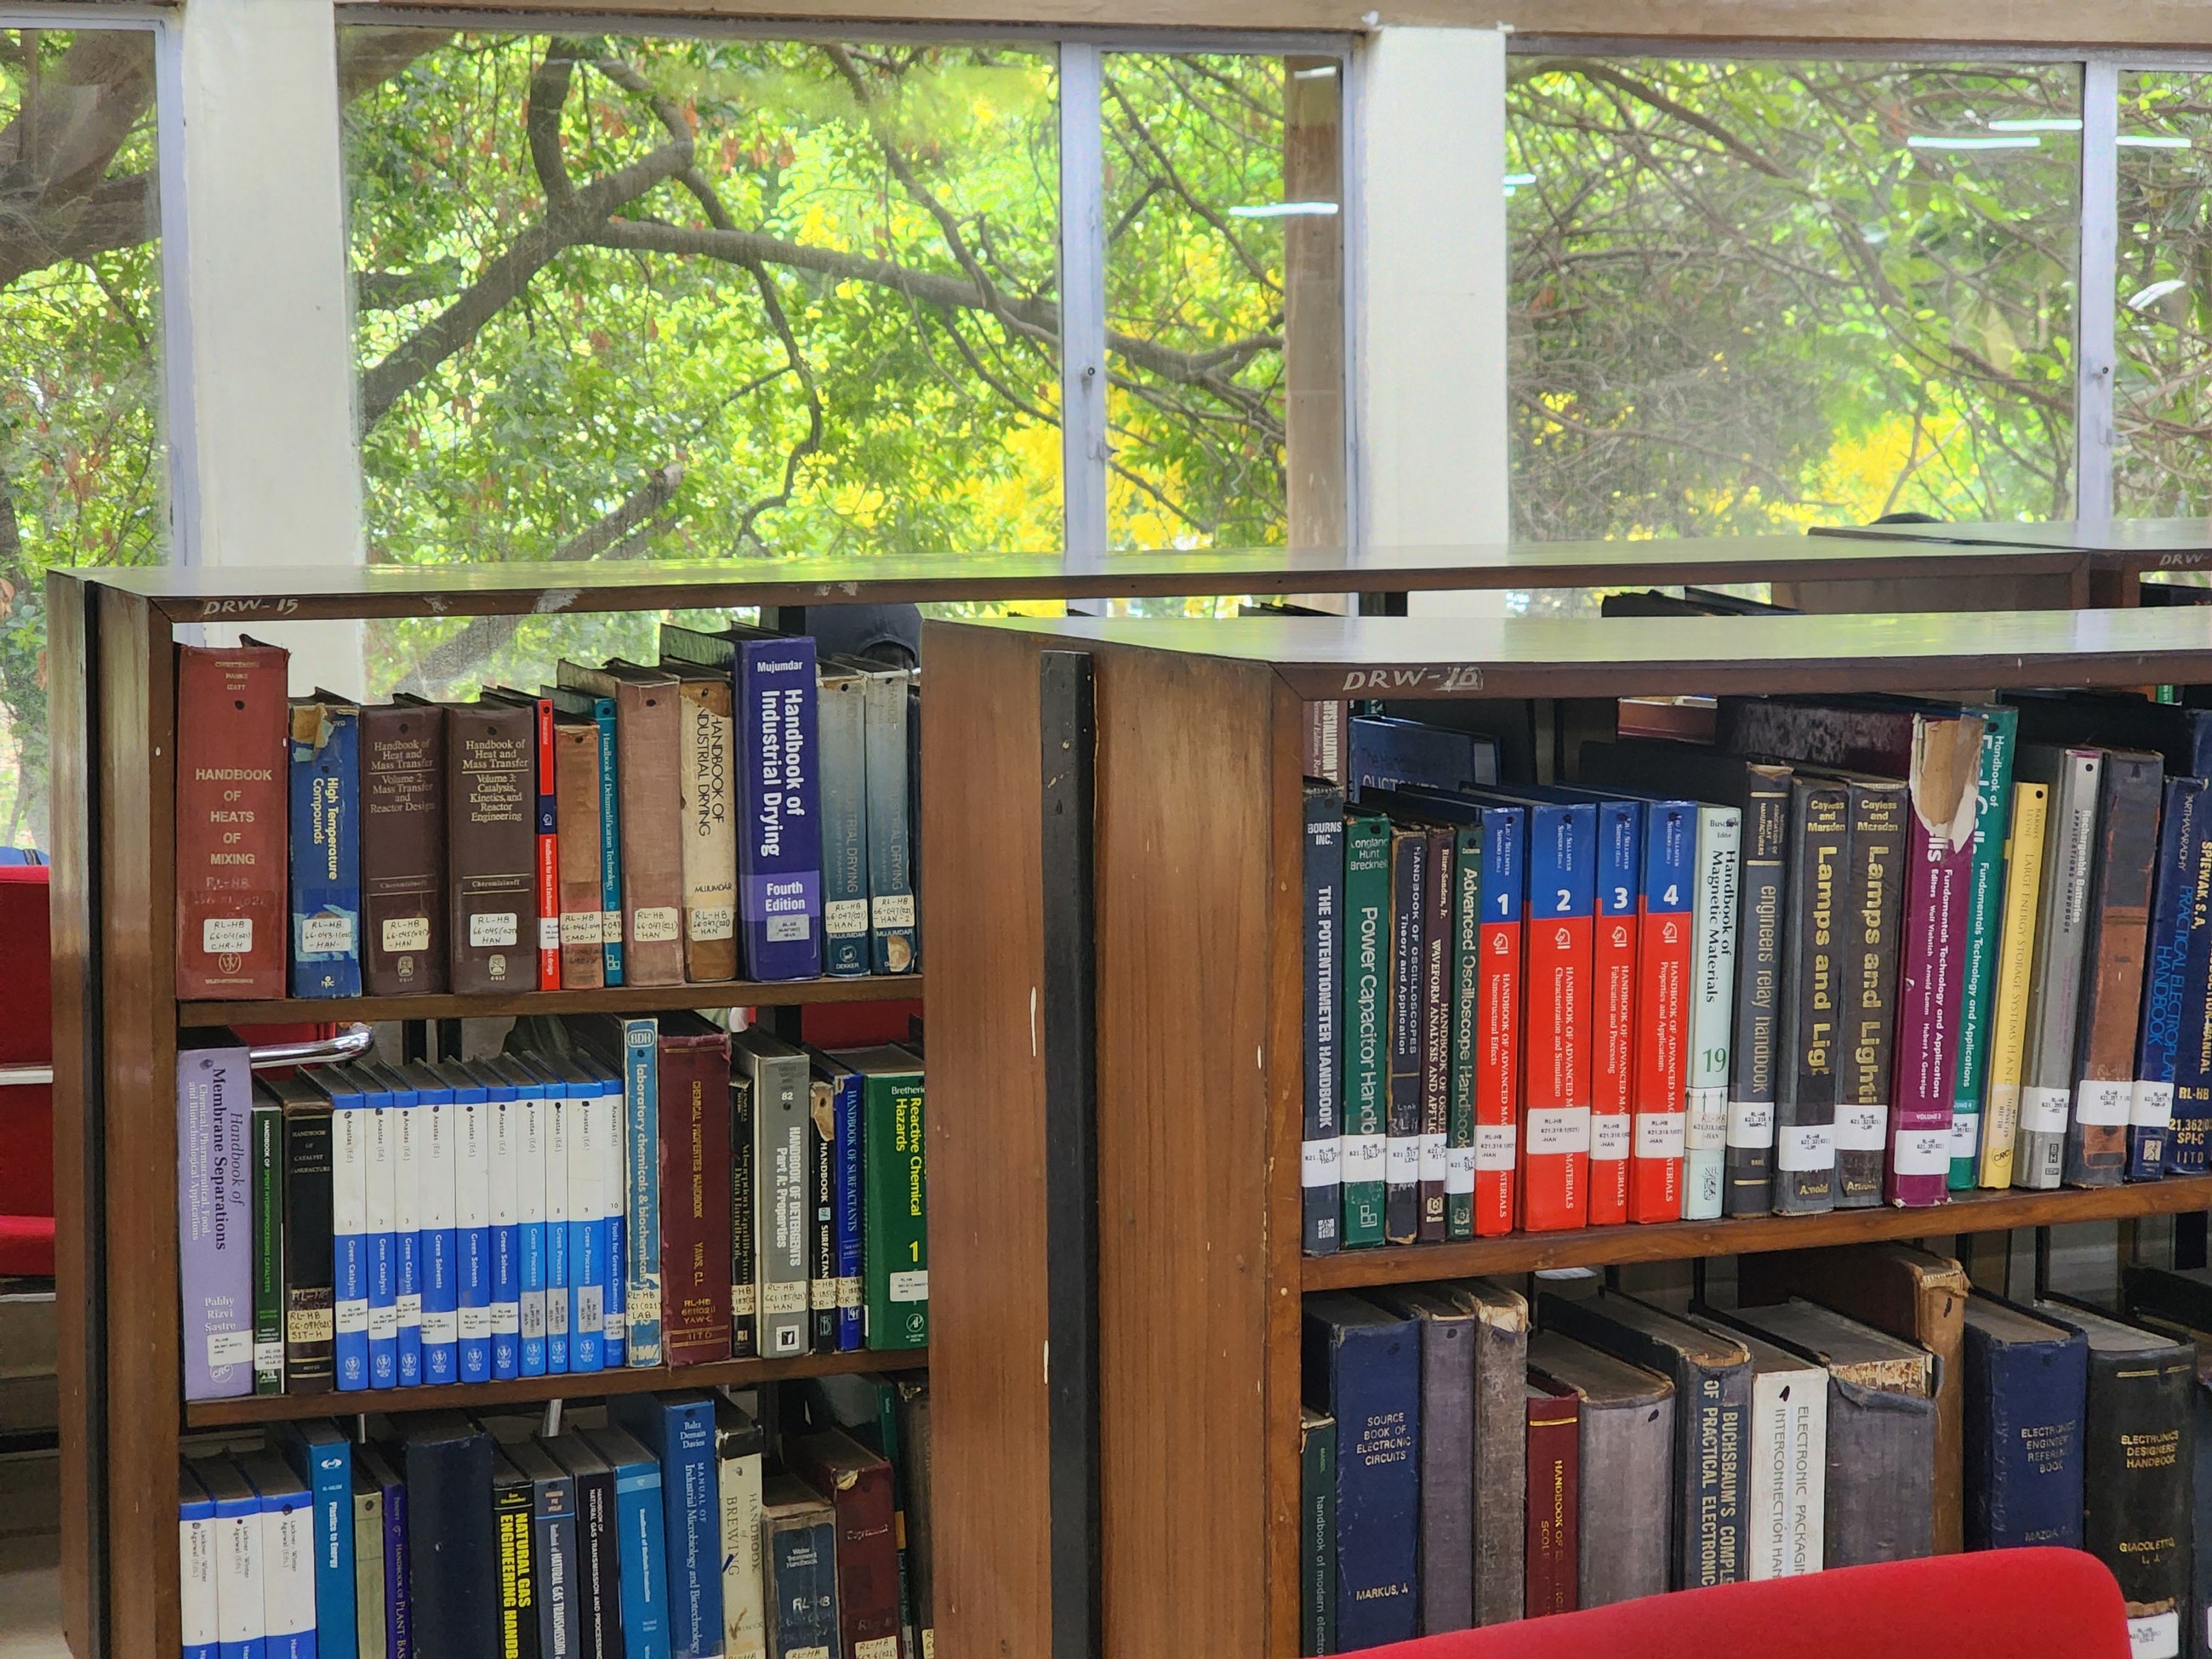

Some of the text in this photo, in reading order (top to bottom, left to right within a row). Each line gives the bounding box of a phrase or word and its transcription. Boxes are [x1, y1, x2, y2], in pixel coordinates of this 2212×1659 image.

[757, 661, 803, 674] Mujumdar
[463, 758, 528, 769] Mass Transfer
[475, 749, 516, 759] Heat and
[784, 689, 805, 816] Handbook of
[196, 769, 271, 781] HANDBOOK
[761, 690, 784, 857] Industrial Drying
[224, 790, 242, 801] OF
[313, 778, 325, 844] Compounds
[481, 801, 513, 812] Reactor
[211, 812, 254, 823] HEATS
[328, 777, 339, 880] High Temperature
[471, 812, 522, 823] Engineering
[1308, 823, 1343, 834] BOURNS
[223, 833, 241, 843] OF
[1316, 834, 1333, 845] INC.
[1359, 849, 1380, 859] Hunt
[211, 854, 254, 865] MIXING
[2073, 809, 2091, 924] Rechargeable Batteries
[767, 882, 803, 896] Fourth
[1614, 887, 1628, 909] 3
[1663, 885, 1679, 906] 4
[1929, 869, 1938, 898] Editors
[766, 898, 806, 911] Edition
[1318, 885, 1332, 916] THE
[1497, 894, 1508, 915] 1
[1556, 889, 1571, 911] 2
[1722, 850, 1736, 956] Handbook of
[1928, 904, 1936, 922] Wolf
[1706, 850, 1723, 1003] Magnetic Materials
[1812, 846, 1838, 1011] Lamps and
[1861, 846, 1890, 1008] Lamps and
[1926, 924, 1936, 957] Vielstich
[2172, 884, 2194, 972] PRACTICAL
[1318, 919, 1333, 1043] POTENTIOMETER
[1359, 906, 1378, 1069] Power Capacitor
[1399, 913, 1409, 1056] Theory and Application
[1756, 966, 1773, 1009] relay
[1924, 963, 1933, 989] Arnold
[1932, 869, 1953, 1099] Fundamentals Technology and Applications
[1429, 938, 1441, 1092] WAVEFORM ANALYSIS AND
[1668, 961, 1679, 1090] HANDBOOK OF ADVANCED
[630, 1031, 651, 1044] BDH
[1702, 1047, 1726, 1073] 19
[1752, 1014, 1771, 1094] handbook
[782, 1092, 794, 1101] 82
[1318, 1045, 1332, 1129] HANDBOOK
[895, 1097, 907, 1152] Hazards
[212, 1069, 227, 1251] Membrane Separations
[636, 1063, 649, 1282] laboratory chemicals & biochemicals
[847, 1090, 857, 1232] HANDBOOK OF SURFACTANTS
[909, 1097, 921, 1216] Reactive Chemical
[790, 1126, 801, 1267] HANDBOOK OF DETERGENTS
[818, 1142, 830, 1221] HANDBOOK of
[775, 1148, 788, 1248] Part A: Properties
[909, 1241, 918, 1262] 1
[347, 1263, 356, 1297] Catalysis
[204, 1320, 237, 1332] Sastre
[207, 1309, 234, 1320] Rizvi
[681, 1429, 706, 1440] Demain
[1364, 1425, 1406, 1440] BOOK OF
[1367, 1412, 1404, 1425] SOURCE
[682, 1439, 705, 1448] Davies
[1356, 1436, 1411, 1454] ELECTRONIC
[1365, 1451, 1406, 1466] CIRCUITS
[1796, 1406, 1810, 1496] ELECTRONIC
[1720, 1411, 1739, 1518] BUCHSBAUM'S
[1772, 1409, 1786, 1548] INTERCONNECTION
[697, 1462, 707, 1523] MANUAL OF
[1554, 1460, 1564, 1548] HANDBOOK OF
[330, 1532, 338, 1542] to
[329, 1542, 339, 1569] Energy
[515, 1513, 531, 1607] NATURAL GAS
[1316, 1496, 1326, 1612] handbook of modern
[551, 1553, 566, 1656] NATURAL GAS TRANSMISSION
